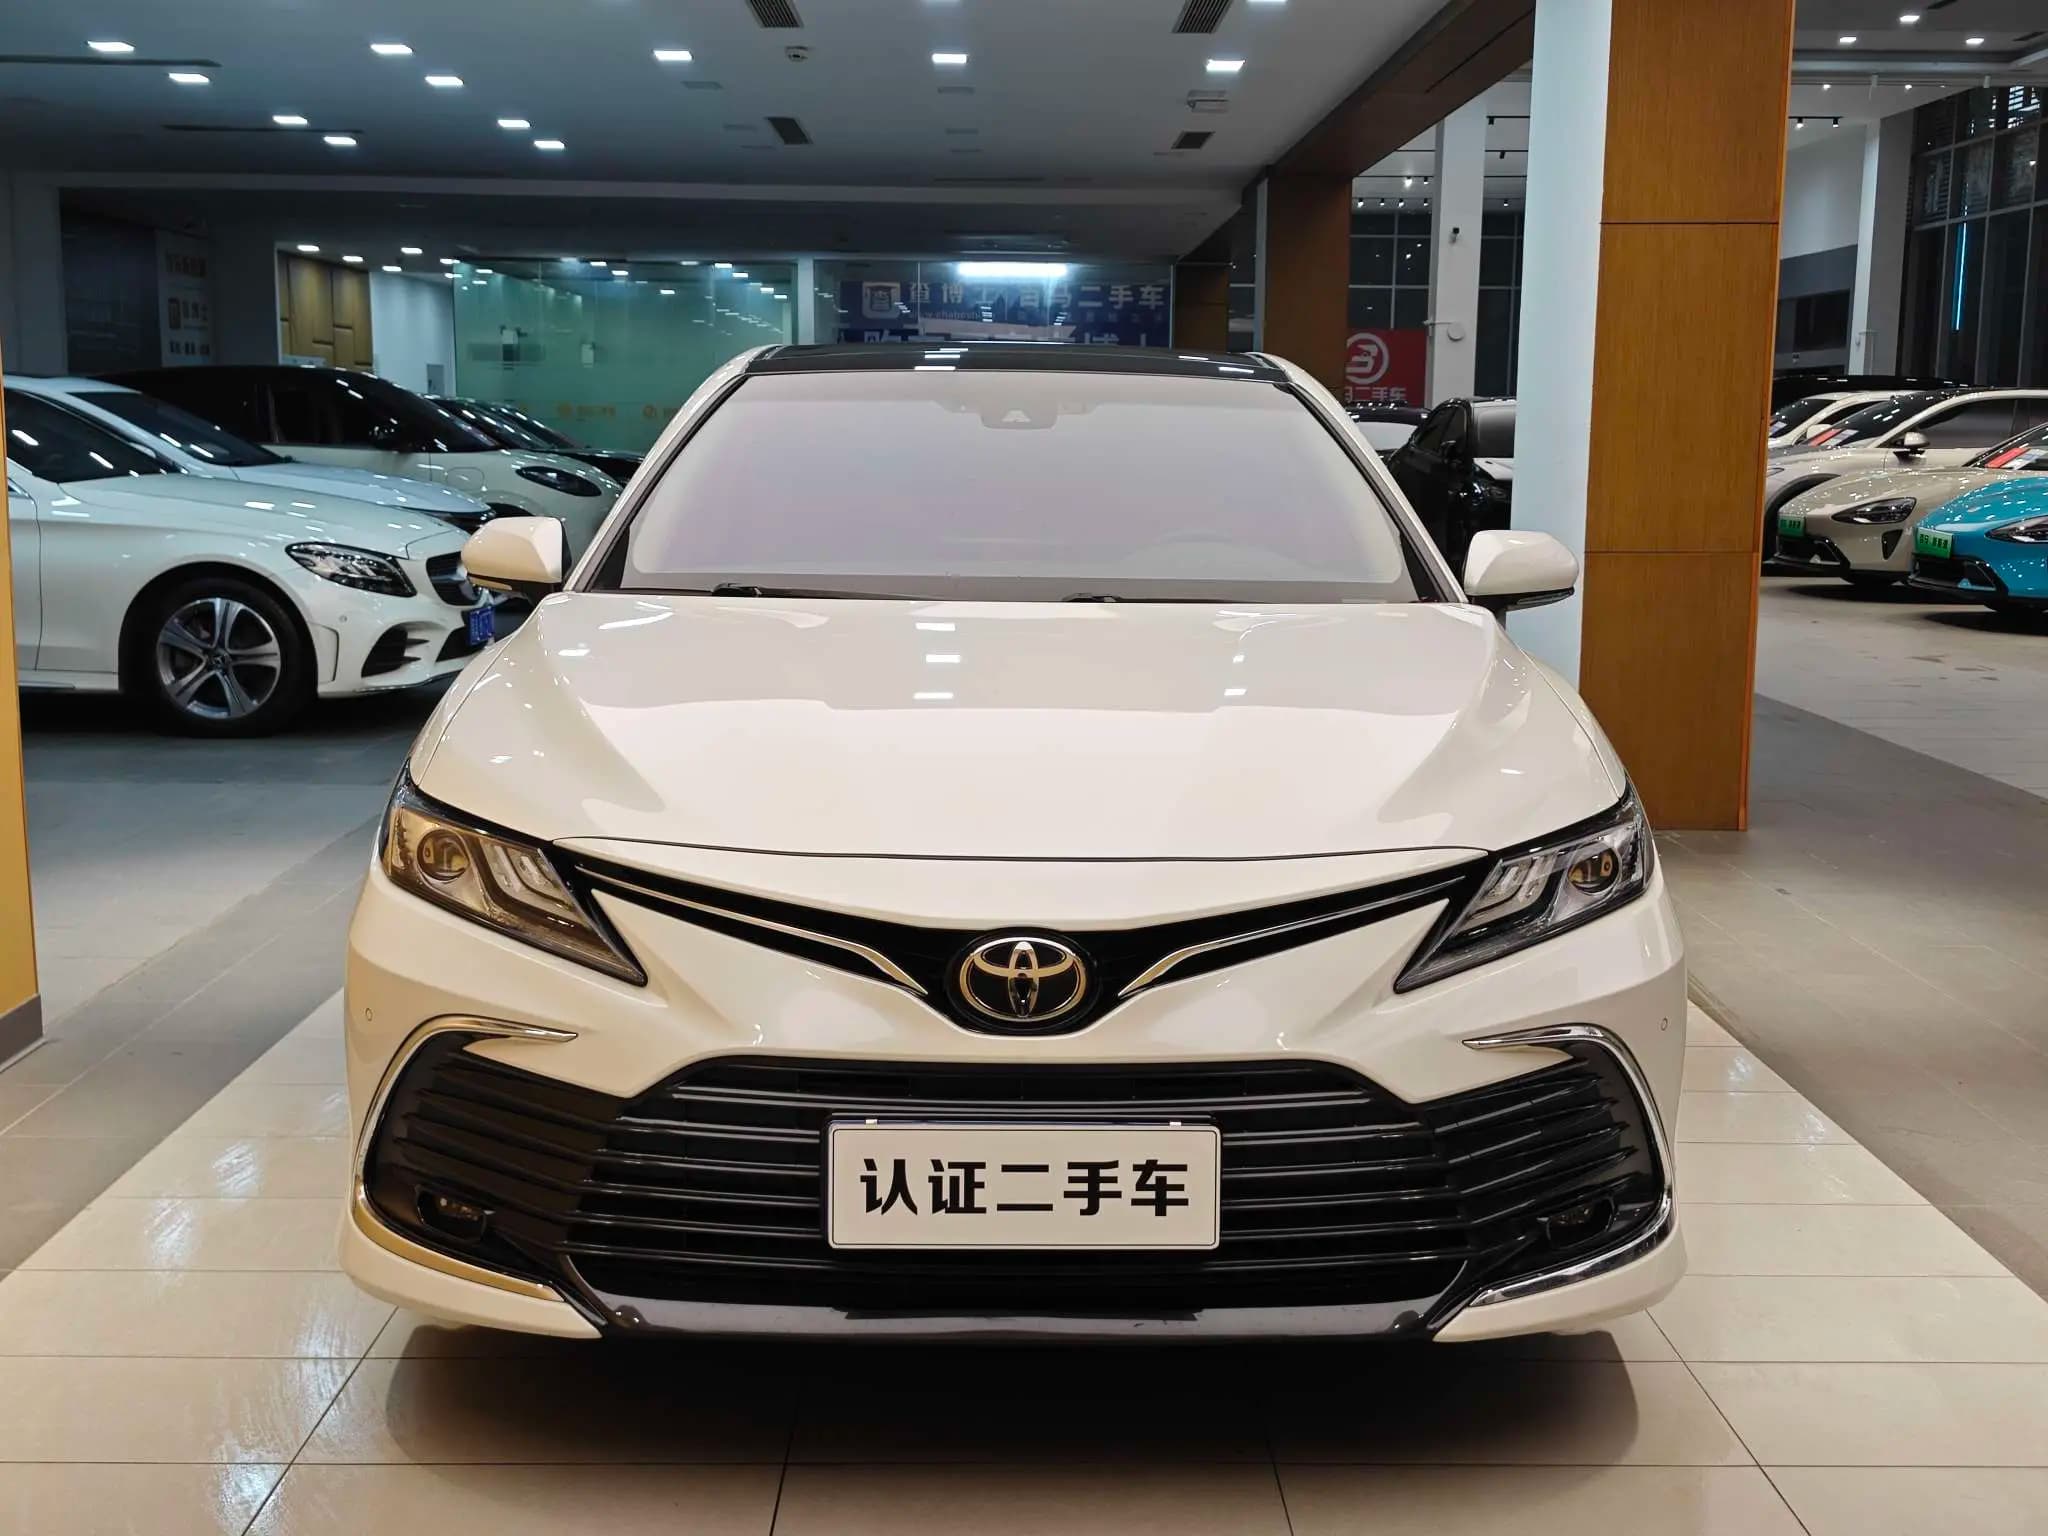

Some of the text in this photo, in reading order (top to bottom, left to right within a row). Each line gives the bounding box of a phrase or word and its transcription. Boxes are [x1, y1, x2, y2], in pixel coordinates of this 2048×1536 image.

[860, 1158, 1189, 1216] 认证二手车
